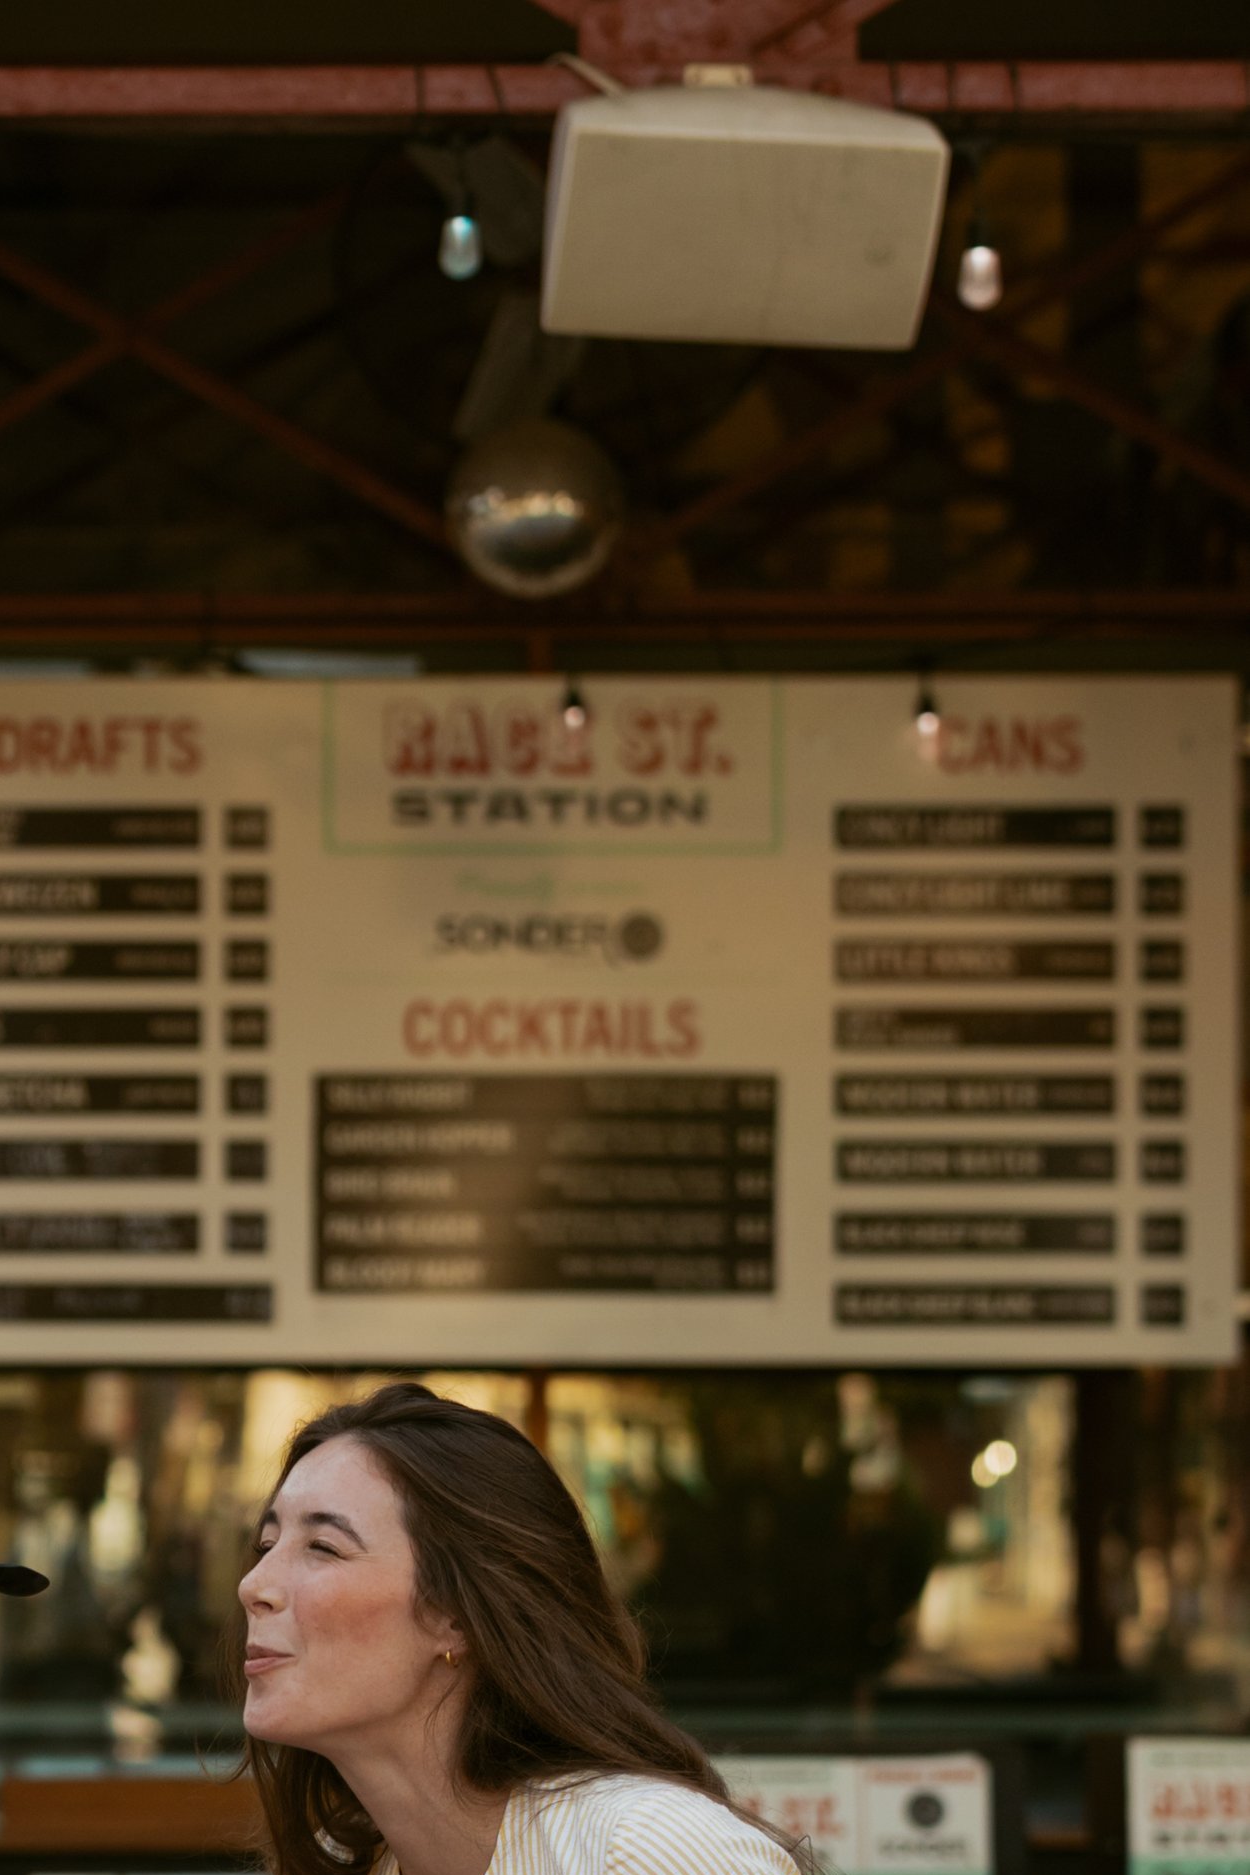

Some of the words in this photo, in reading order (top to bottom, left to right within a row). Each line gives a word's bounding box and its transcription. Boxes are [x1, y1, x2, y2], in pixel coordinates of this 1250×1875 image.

[936, 714, 1088, 776] CANS
[391, 787, 712, 828] STATION
[434, 914, 608, 954] SONDER
[401, 998, 706, 1057] COCKTAILS
